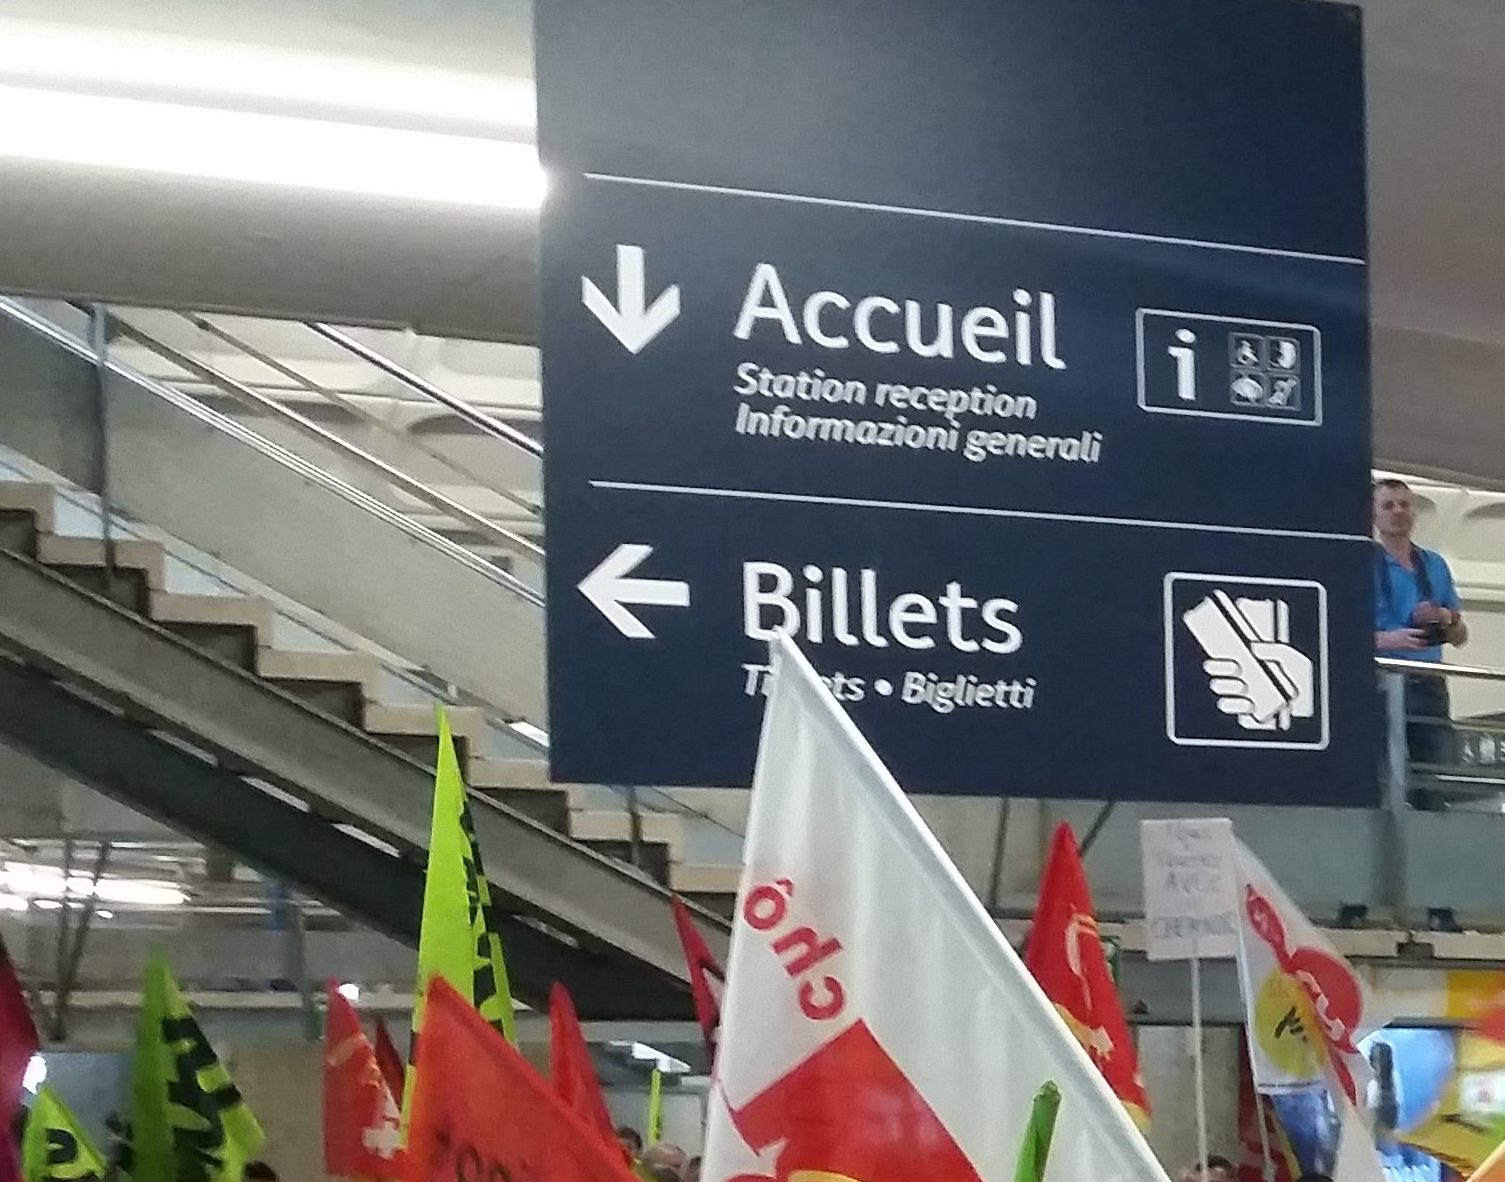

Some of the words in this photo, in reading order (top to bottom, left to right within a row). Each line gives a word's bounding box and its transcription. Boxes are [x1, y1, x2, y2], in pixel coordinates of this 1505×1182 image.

[733, 262, 1067, 371] Accueil
[733, 361, 867, 406] Station
[874, 379, 1038, 423] reception
[734, 402, 960, 452] Informazioni
[962, 428, 1104, 463] generali
[742, 561, 1024, 654] Billets
[741, 662, 866, 702] Tits
[901, 671, 1038, 714] Biglietti
